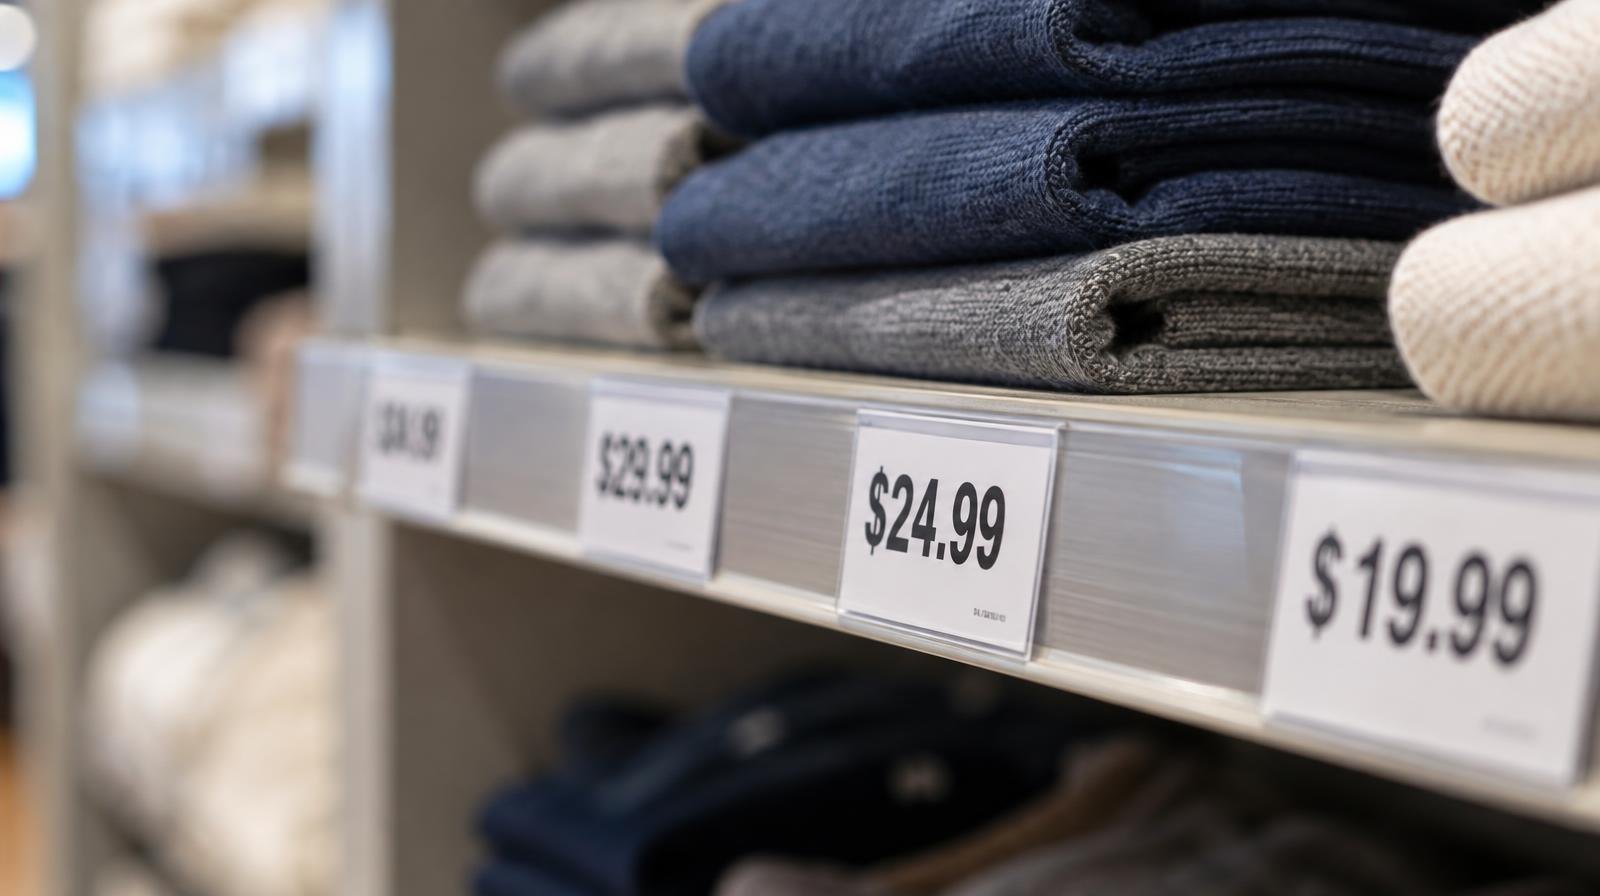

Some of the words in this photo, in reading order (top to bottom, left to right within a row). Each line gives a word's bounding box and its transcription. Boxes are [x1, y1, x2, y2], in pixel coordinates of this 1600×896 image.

[596, 433, 694, 509] $29.99
[865, 466, 1006, 570] $24.99
[1305, 529, 1538, 670] $19.99
